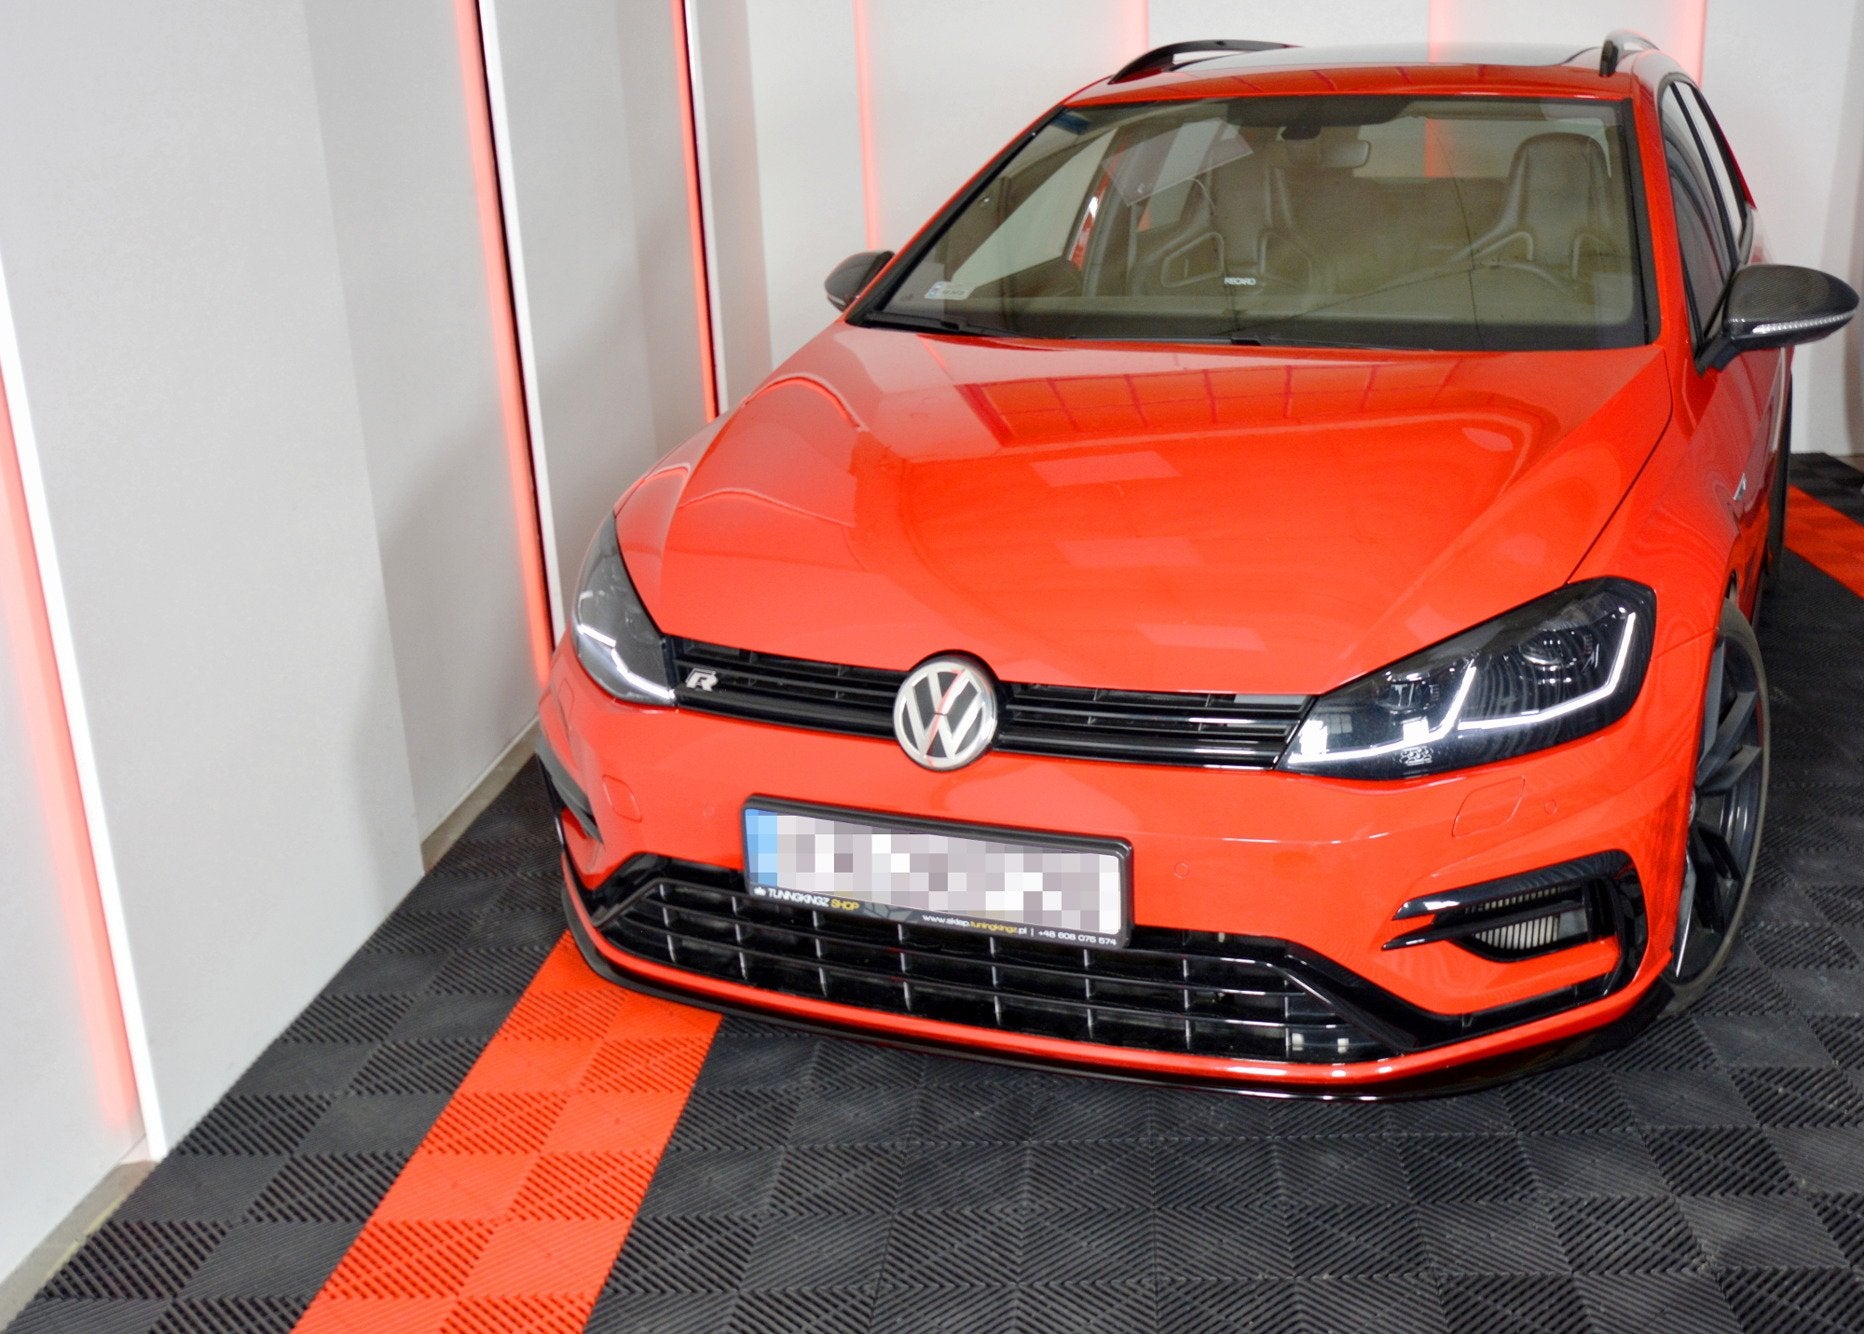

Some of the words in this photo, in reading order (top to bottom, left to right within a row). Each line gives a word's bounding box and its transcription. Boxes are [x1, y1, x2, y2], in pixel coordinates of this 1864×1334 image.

[685, 668, 718, 692] R
[831, 899, 860, 911] SHOP
[922, 914, 1027, 936] www.sklep.tuningkingz.pl
[1038, 930, 1056, 939] +48
